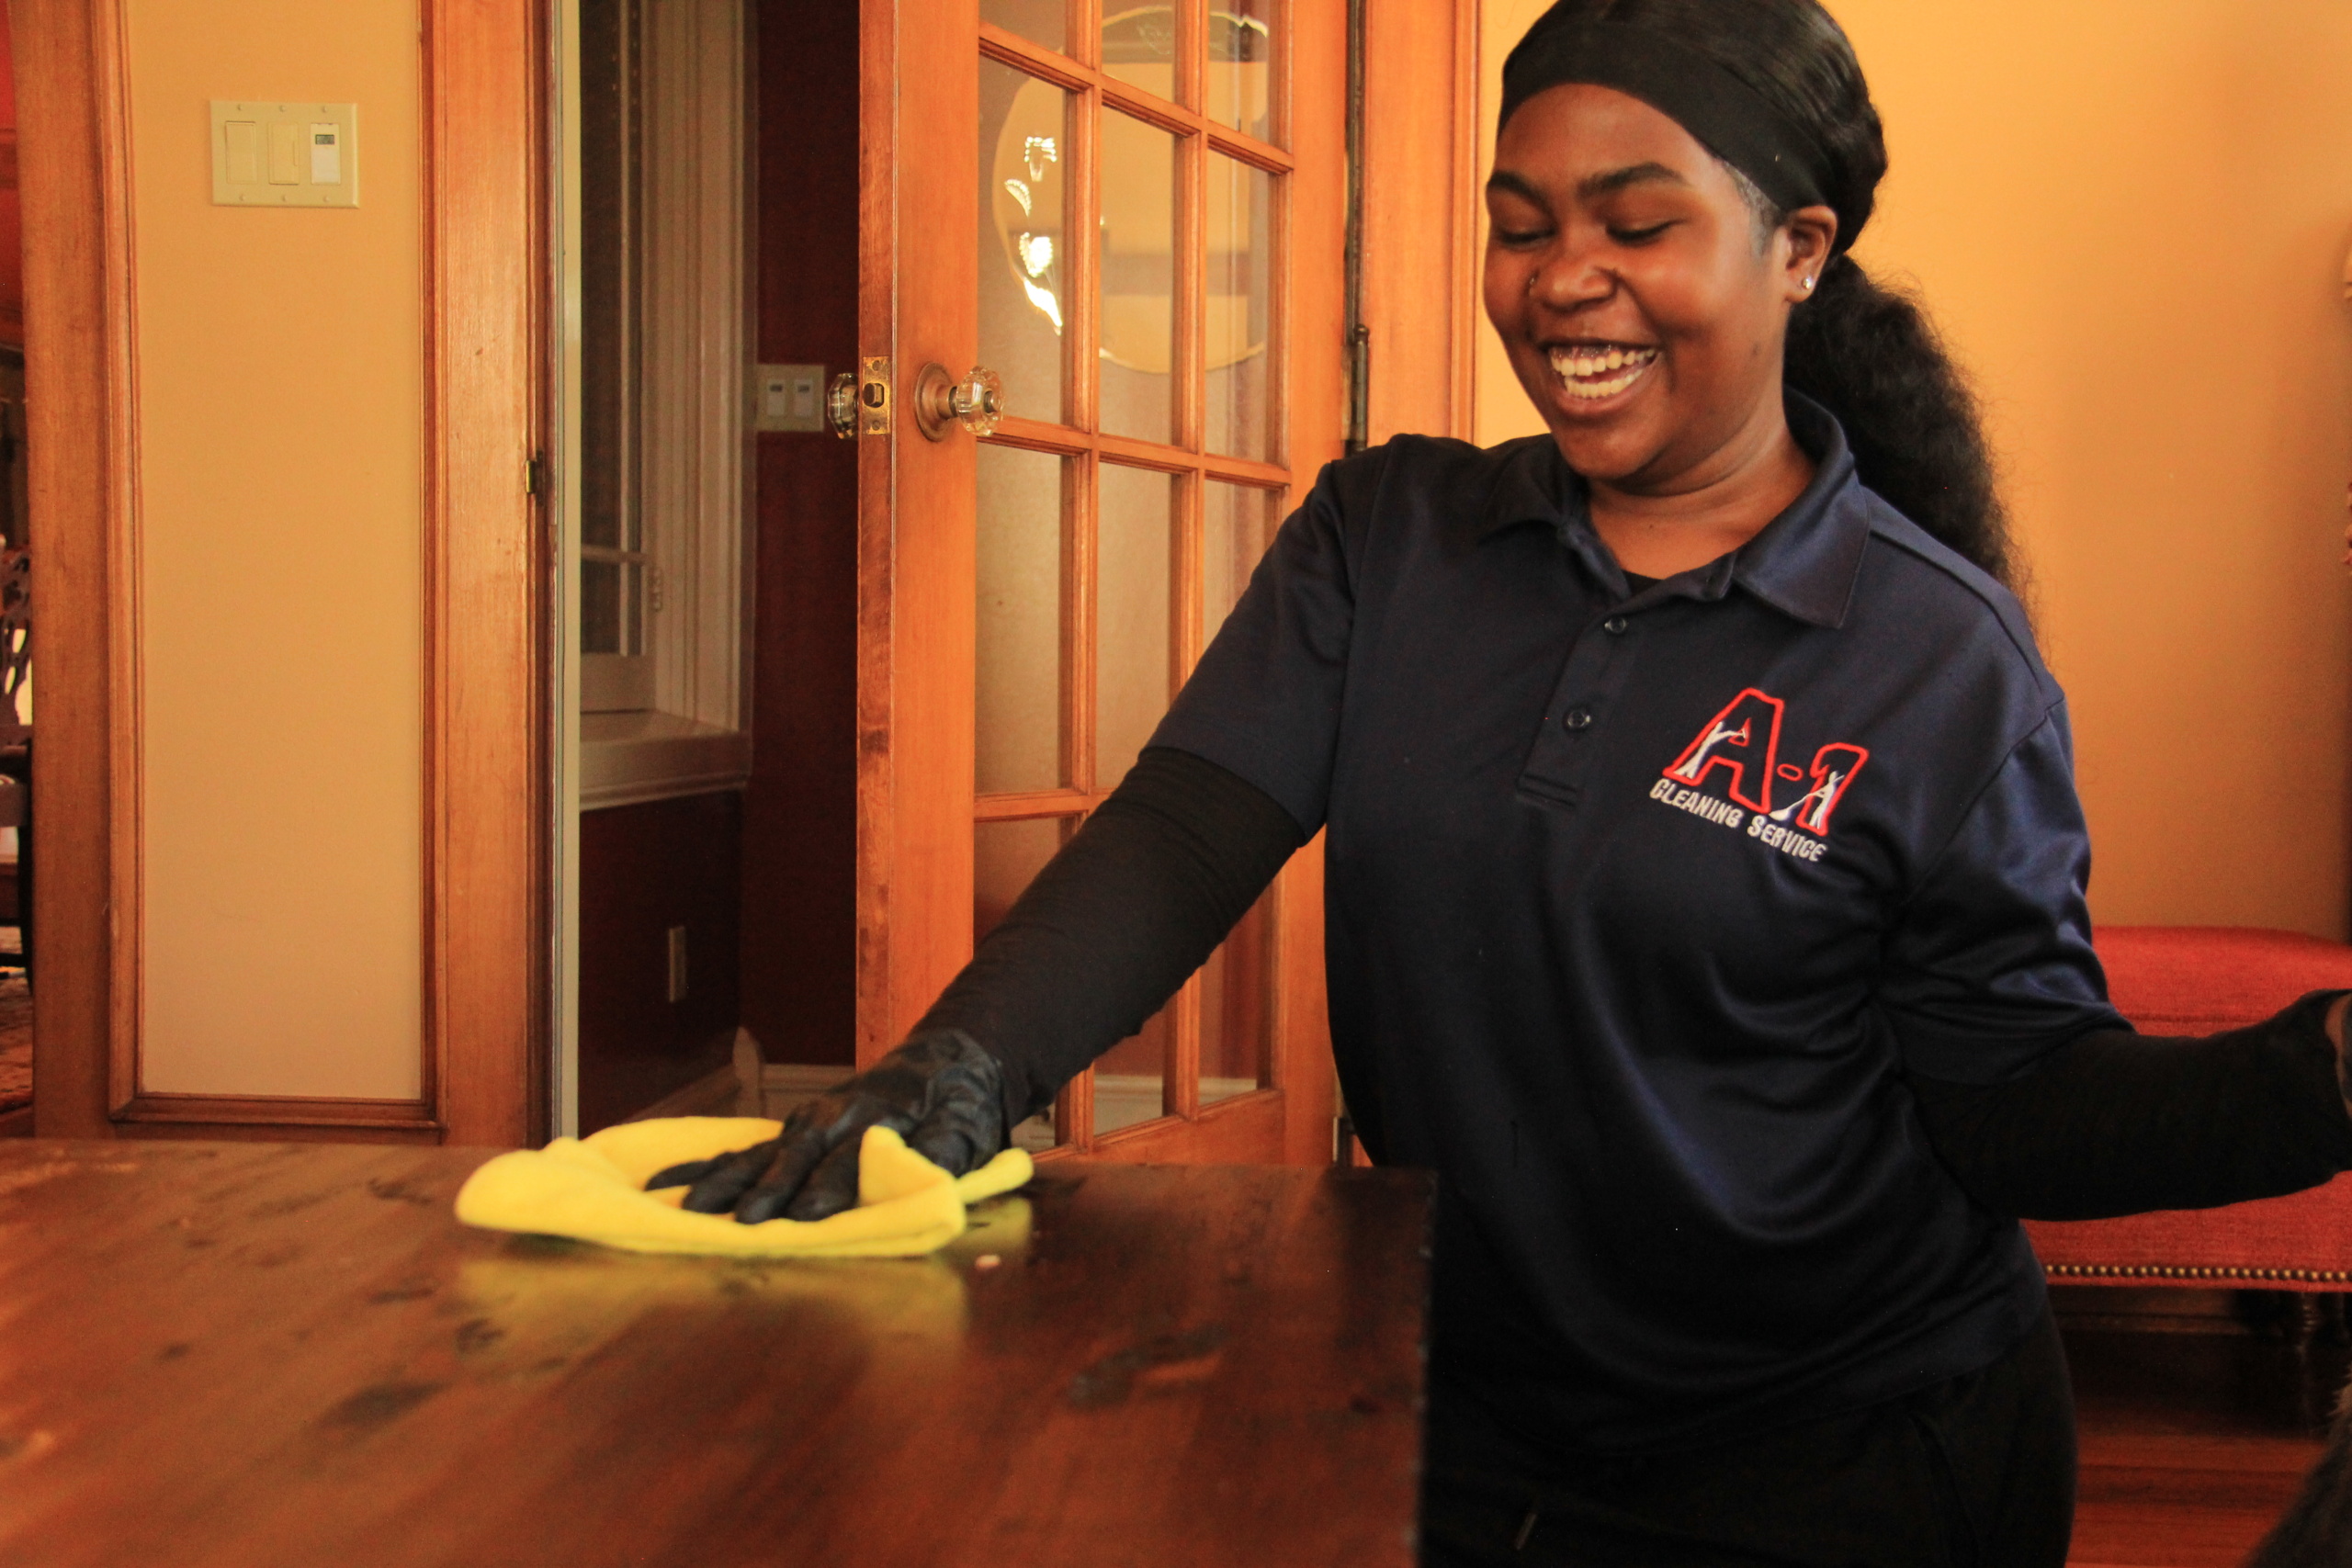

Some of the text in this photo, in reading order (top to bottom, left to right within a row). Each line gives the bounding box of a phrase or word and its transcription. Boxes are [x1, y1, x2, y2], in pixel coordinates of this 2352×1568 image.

[1662, 687, 1870, 836] A-1
[1649, 778, 1827, 862] CLEANING SERVICE
